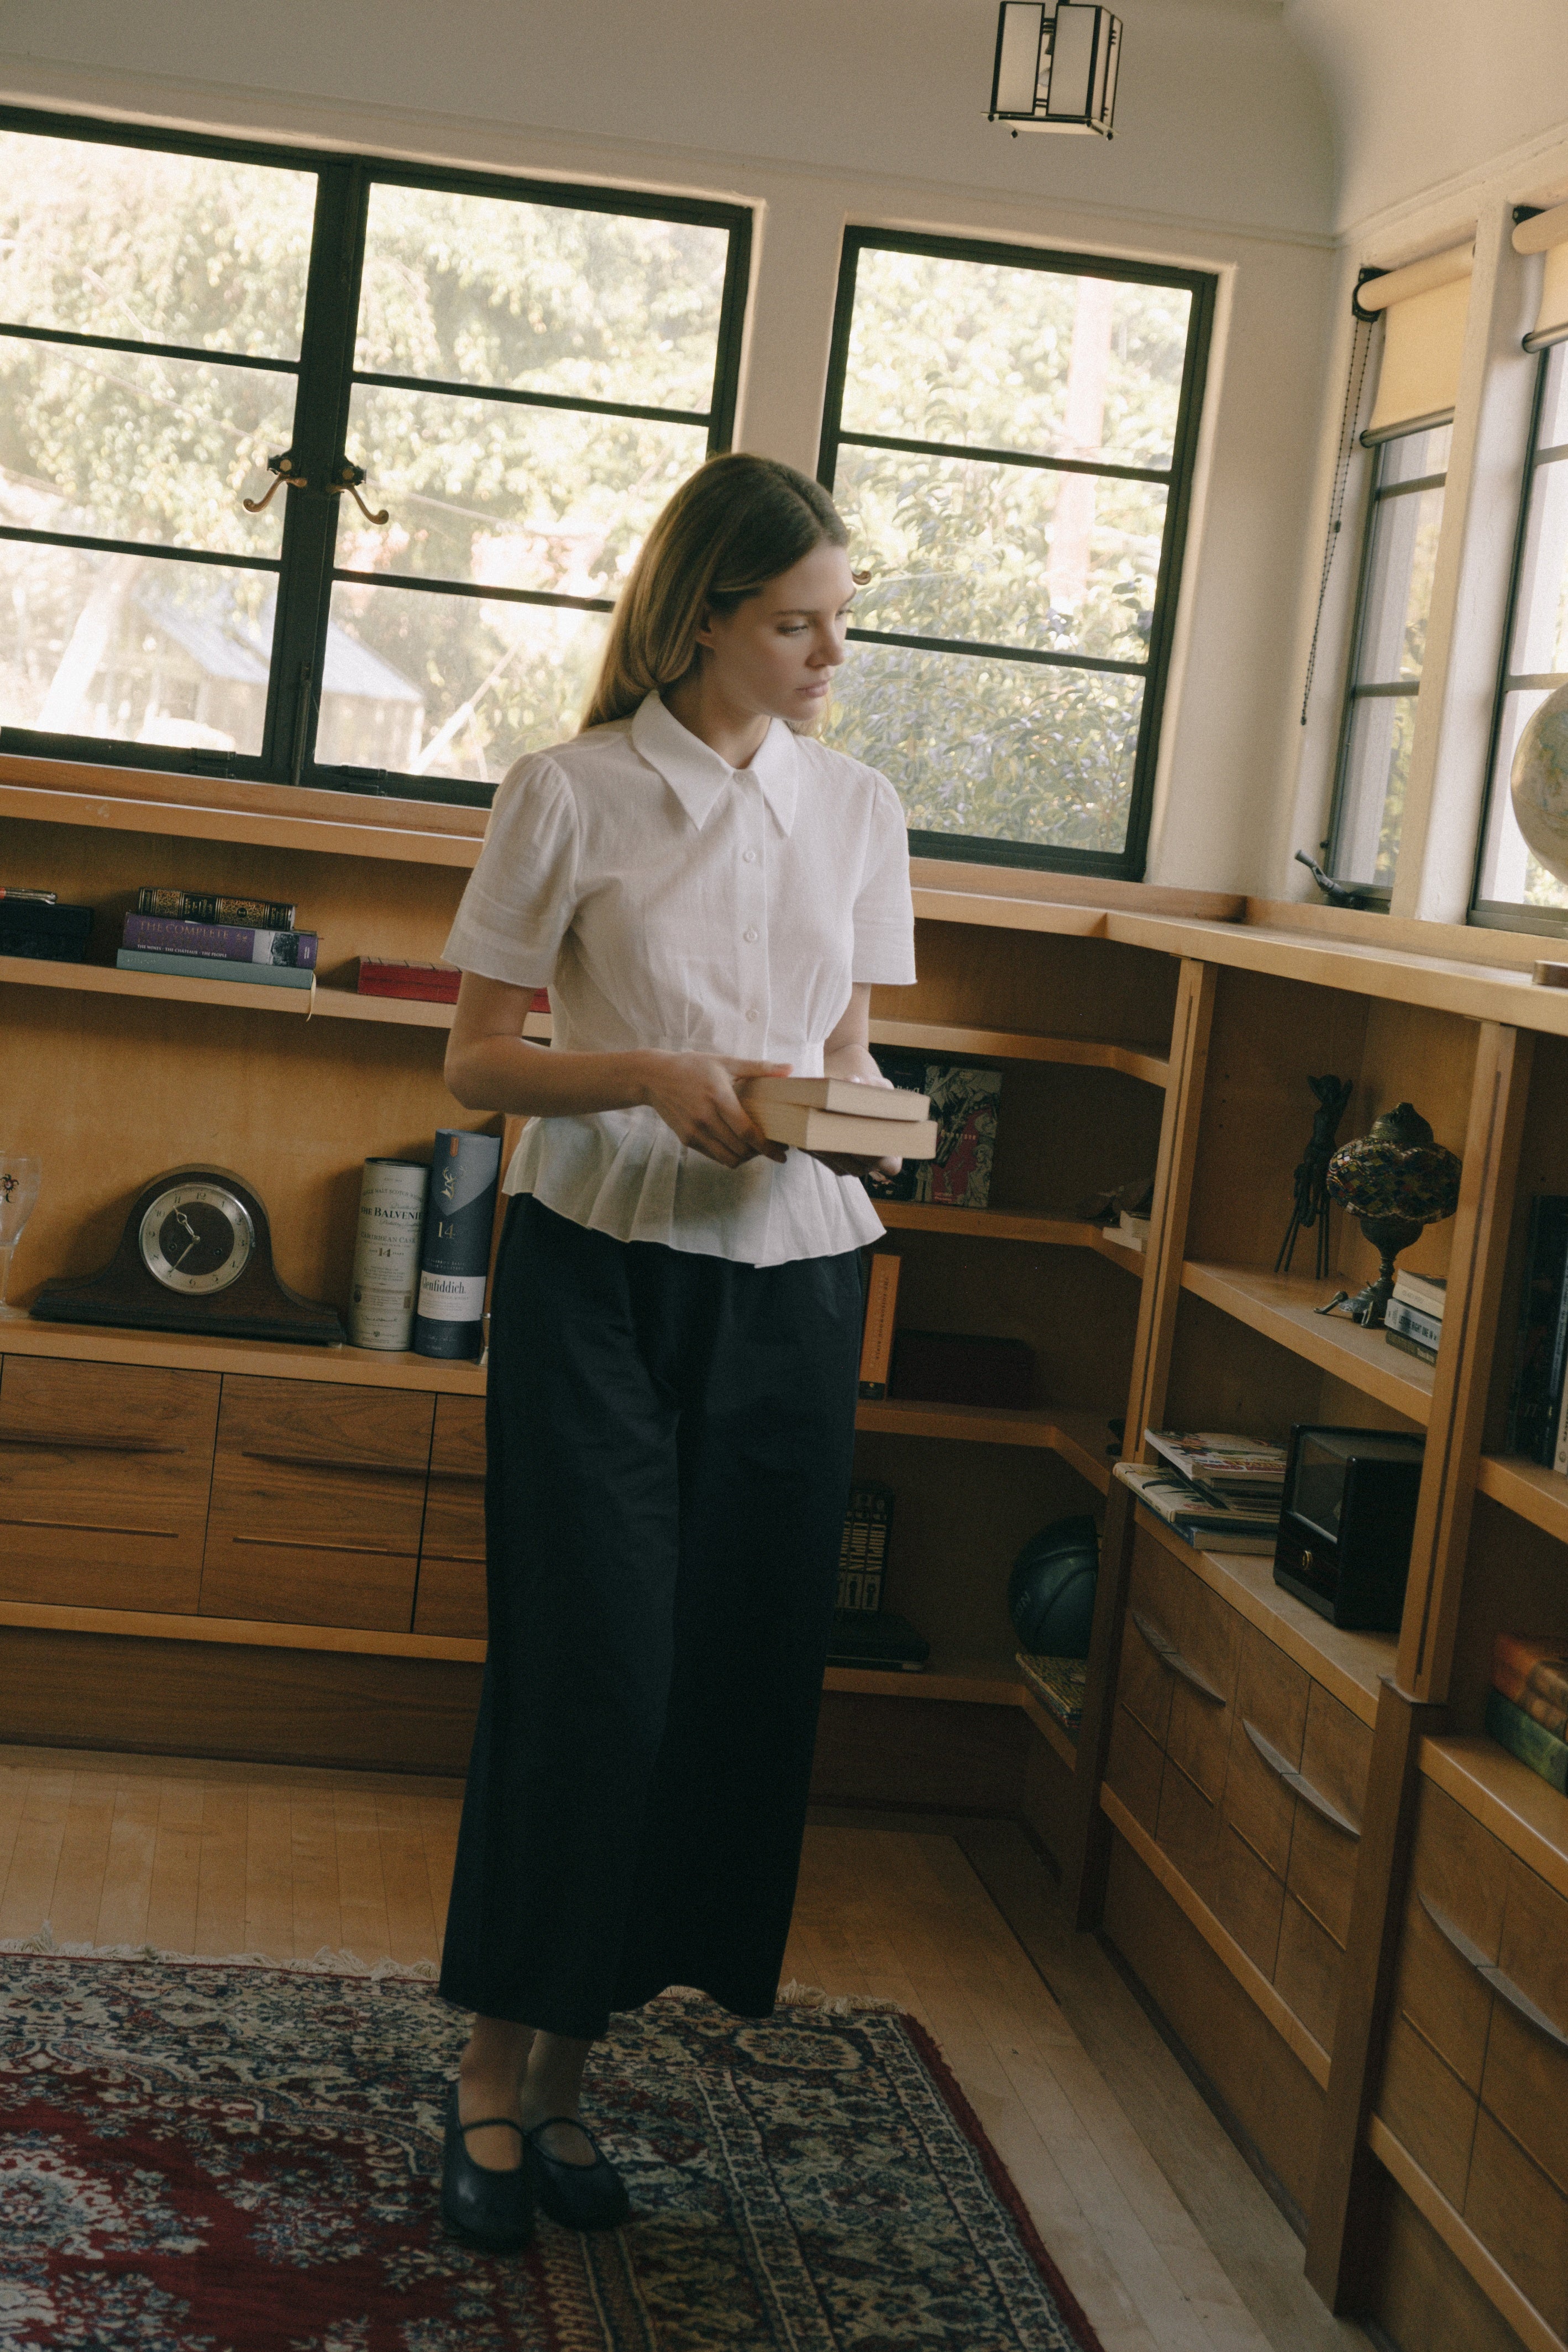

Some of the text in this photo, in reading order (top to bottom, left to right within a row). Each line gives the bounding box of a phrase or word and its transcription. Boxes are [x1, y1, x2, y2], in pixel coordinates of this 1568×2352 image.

[140, 921, 229, 939] THE COMPLETE
[361, 1206, 373, 1215] THE
[438, 1221, 456, 1239] 14
[378, 1248, 391, 1258] 14
